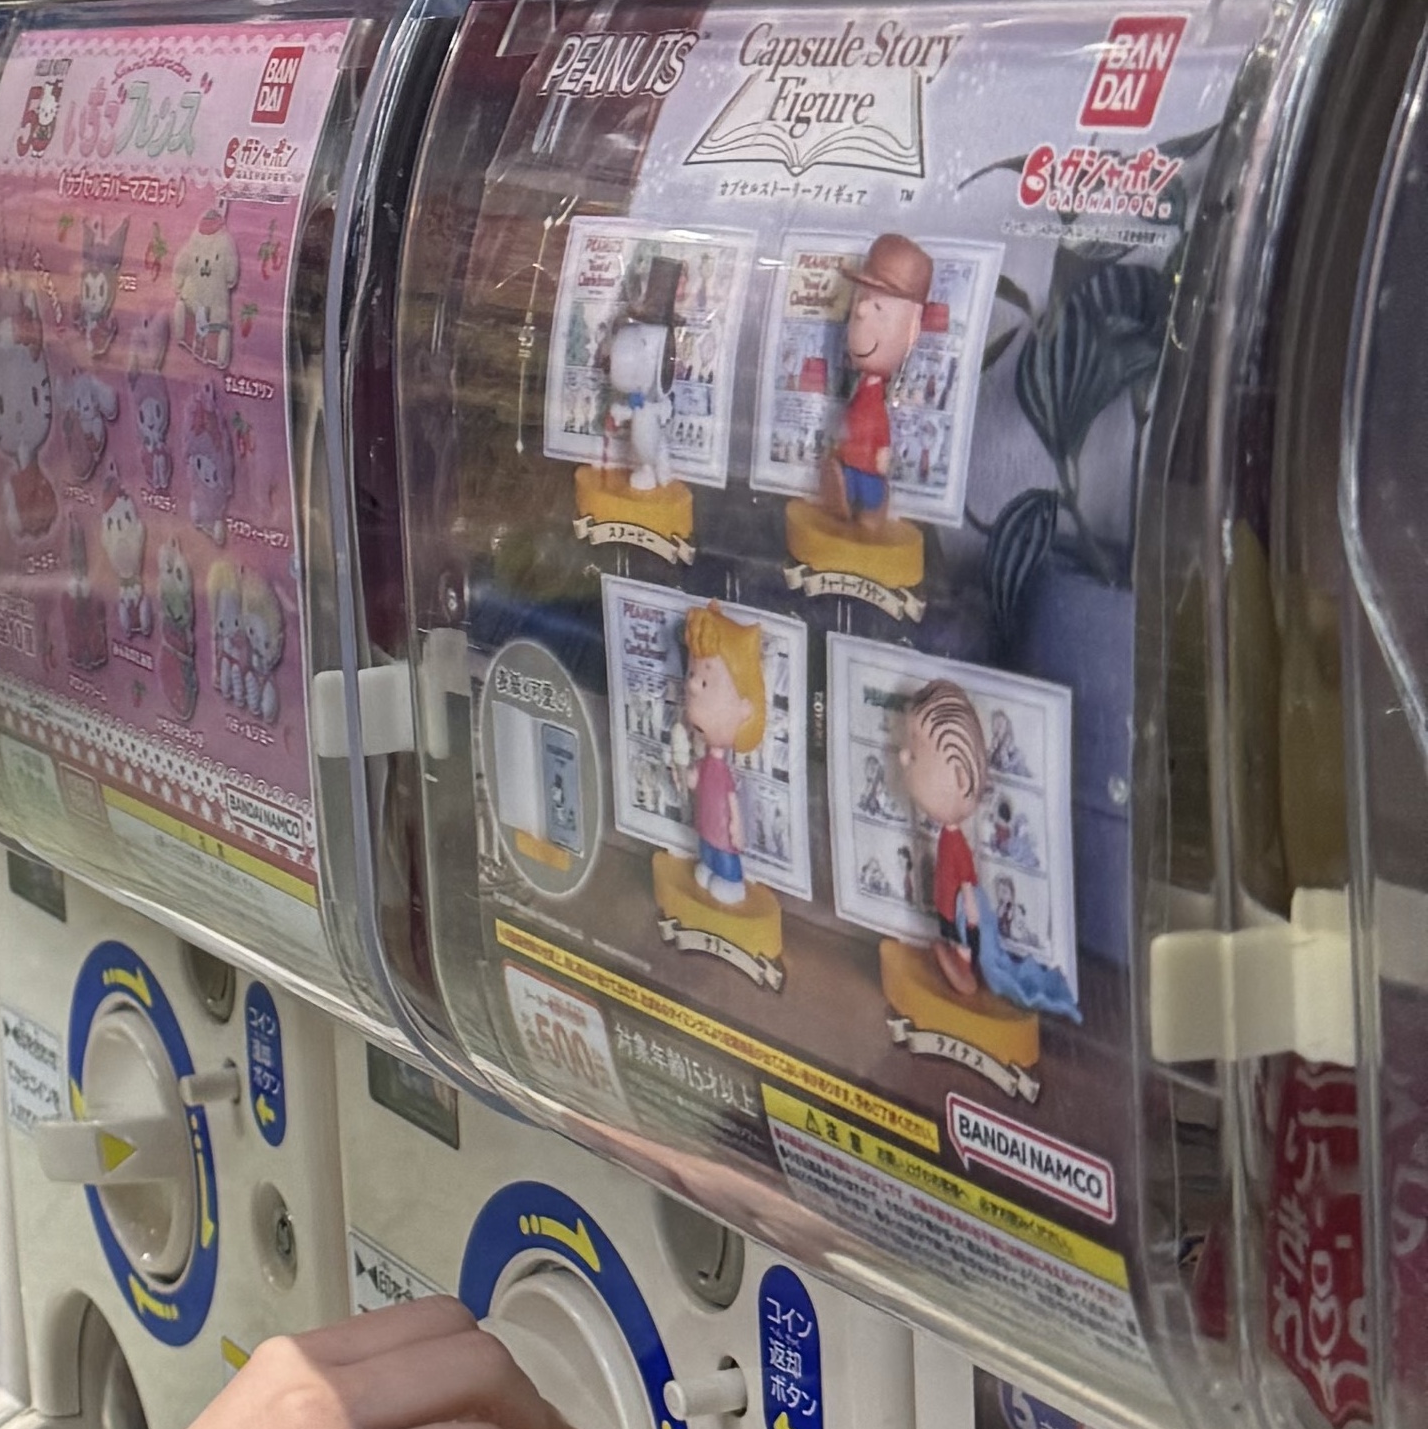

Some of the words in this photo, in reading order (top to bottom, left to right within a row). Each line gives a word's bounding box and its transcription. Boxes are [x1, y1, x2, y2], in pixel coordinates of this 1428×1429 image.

[539, 31, 699, 98] PEANUTS
[739, 23, 865, 72] Capsule
[872, 29, 959, 83] Story
[1107, 33, 1167, 72] BAN
[769, 77, 875, 138] Figure
[1091, 73, 1145, 111] DAI
[958, 1113, 1027, 1166] BANDAI
[1030, 1147, 1103, 1200] NAMCO
[767, 1296, 812, 1338] コイン
[771, 1373, 816, 1416] ボタン
